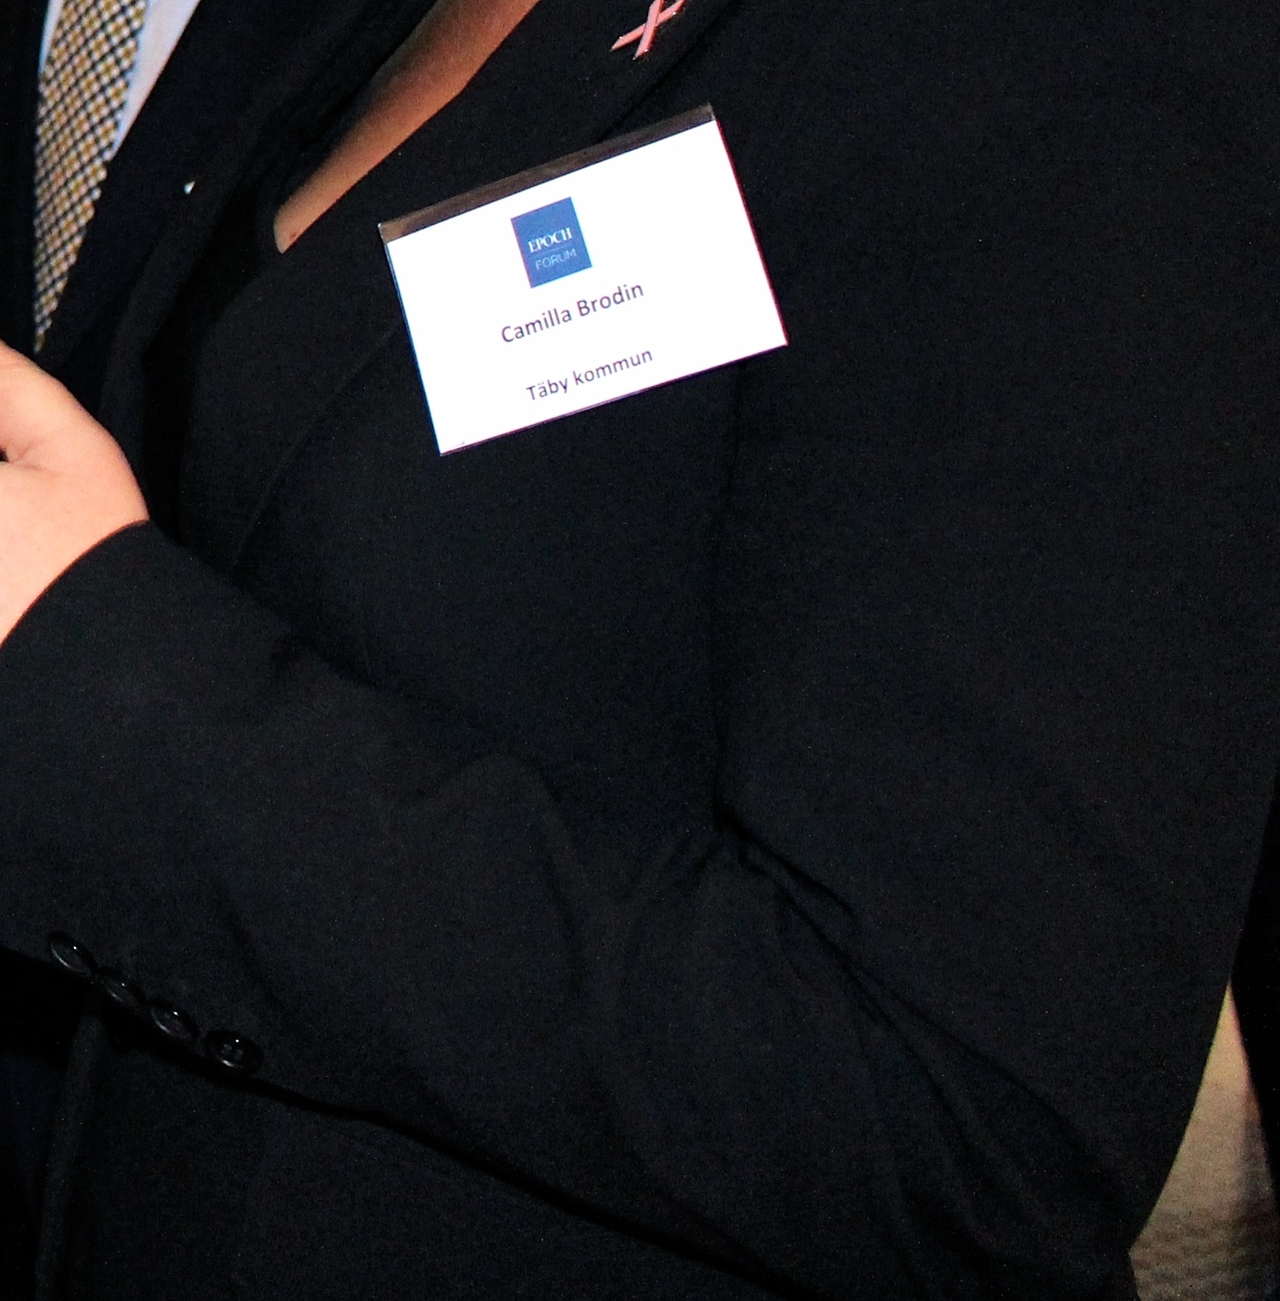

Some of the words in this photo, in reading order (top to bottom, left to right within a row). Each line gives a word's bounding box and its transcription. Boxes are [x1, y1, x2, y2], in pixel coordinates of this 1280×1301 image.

[528, 227, 573, 253] EPOCH
[535, 248, 578, 271] FORUM
[501, 308, 572, 343] Camilla
[576, 283, 644, 317] Brodin
[526, 378, 568, 401] Täby
[573, 350, 653, 386] kommun
